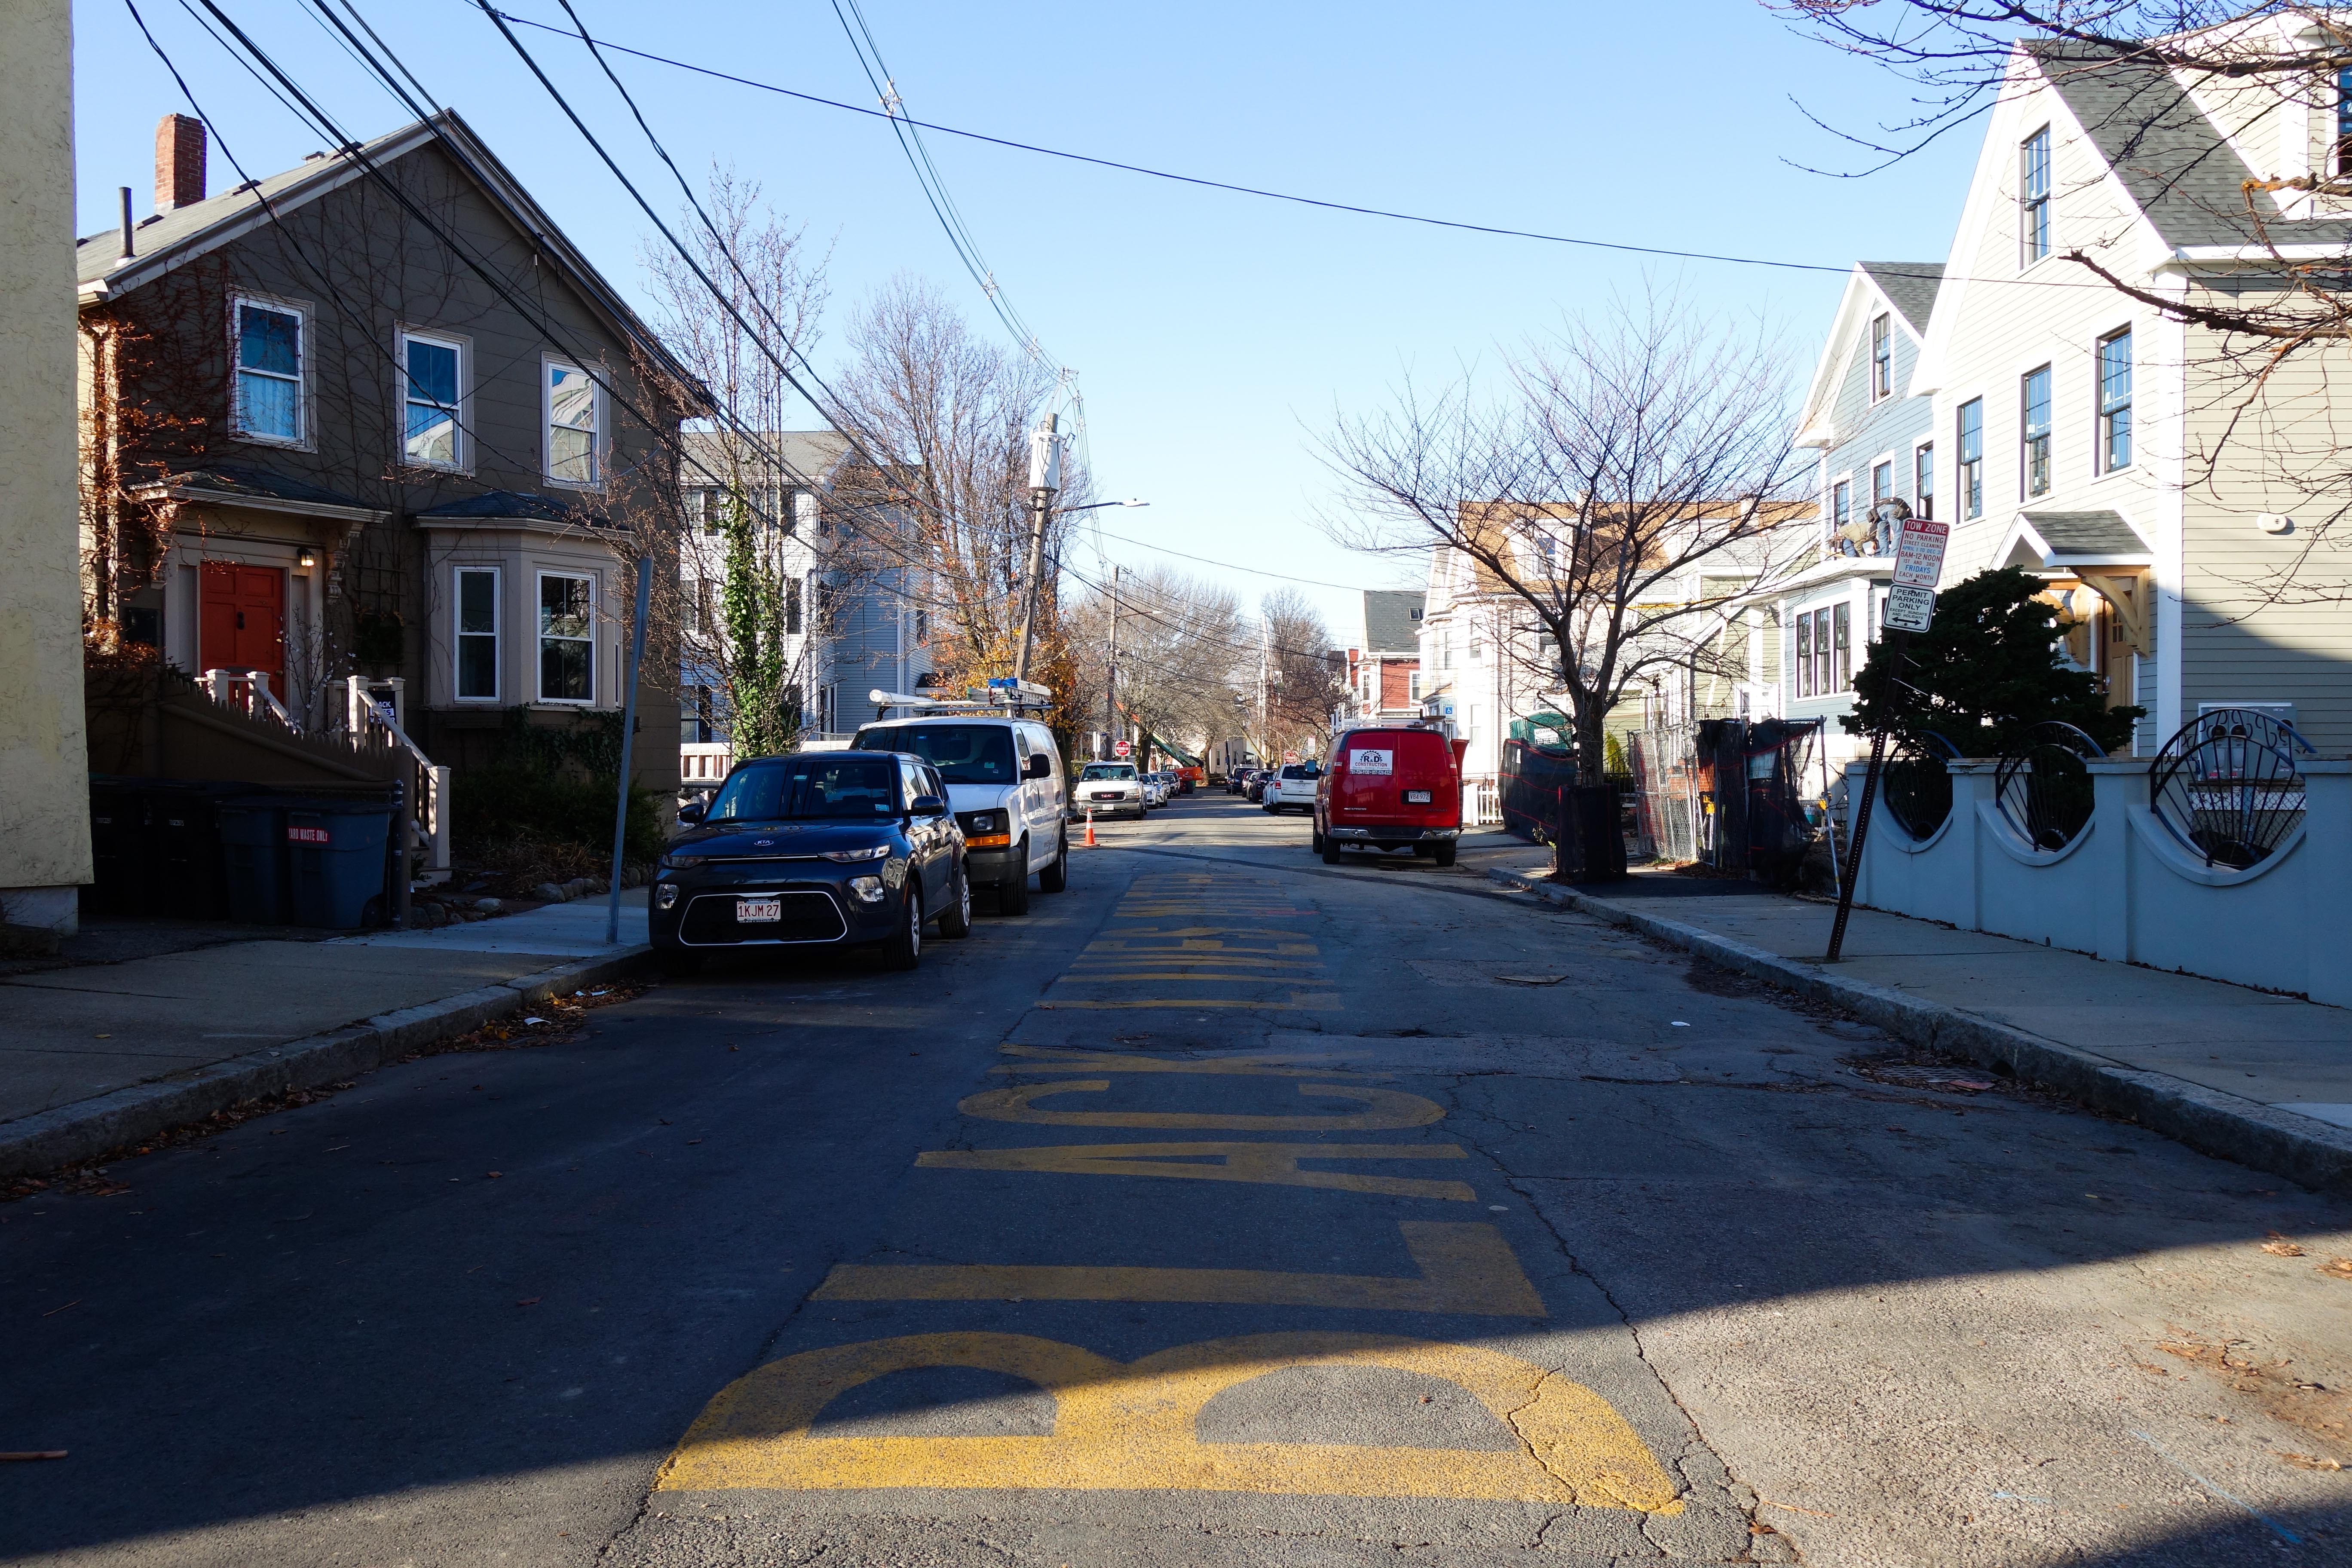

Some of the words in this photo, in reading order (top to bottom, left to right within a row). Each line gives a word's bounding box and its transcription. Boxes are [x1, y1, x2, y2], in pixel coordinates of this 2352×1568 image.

[1906, 521, 1923, 530] TOW
[1925, 524, 1948, 534] ZONE
[1917, 534, 1944, 543] PARKING
[1900, 551, 1922, 560] 8AM-12
[1905, 564, 1930, 573] FRIDAYS
[1896, 589, 1928, 598] PERMIT
[1892, 595, 1929, 605] PARKING
[288, 828, 298, 839] YARD
[300, 829, 315, 841] WASTE
[316, 830, 328, 842] ONLY
[738, 905, 764, 917] 1KJM
[766, 904, 779, 916] 27
[656, 1044, 1685, 1515] BLACK
